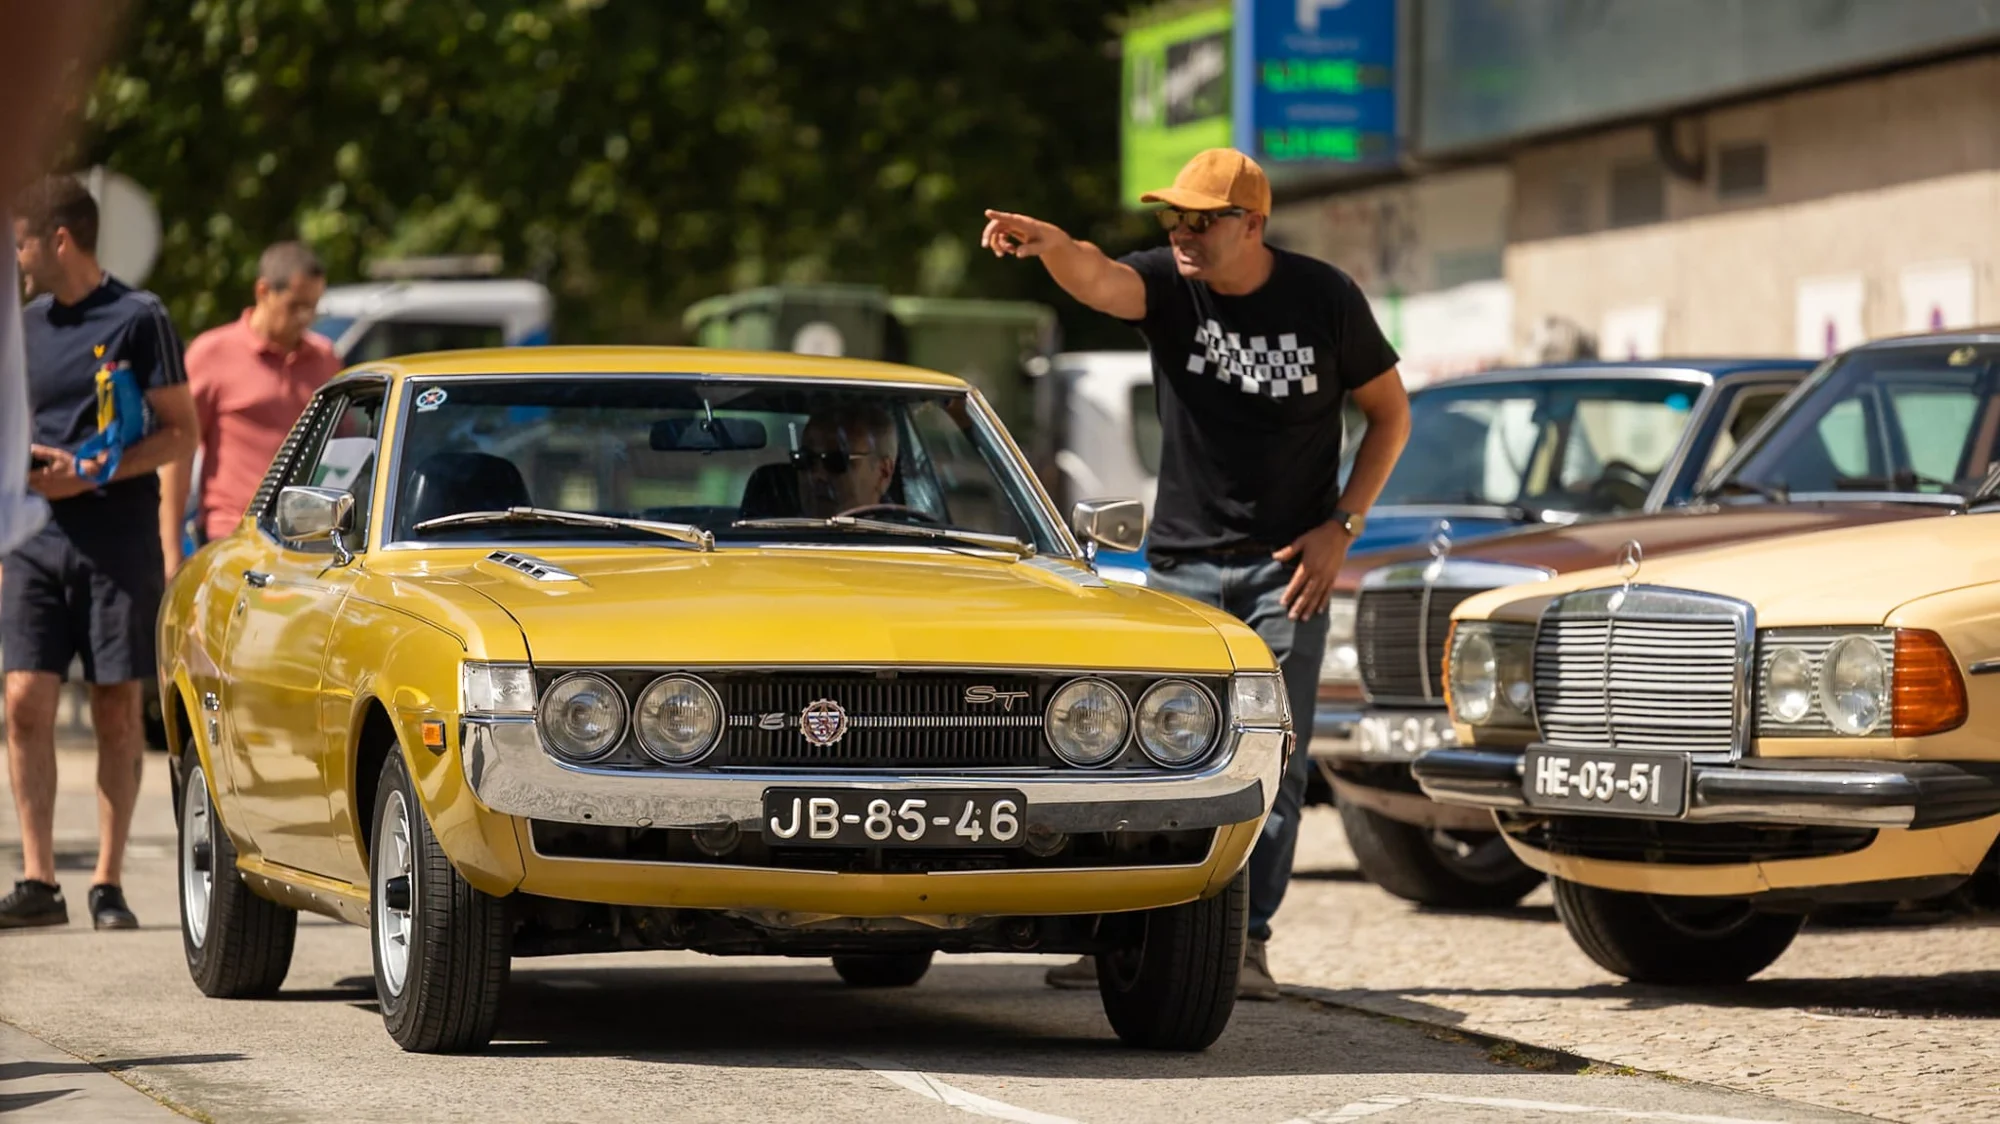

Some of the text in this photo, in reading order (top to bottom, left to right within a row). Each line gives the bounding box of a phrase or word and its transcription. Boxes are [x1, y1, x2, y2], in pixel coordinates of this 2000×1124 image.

[964, 685, 1029, 712] ST
[1536, 756, 1661, 804] HE-03-51
[770, 797, 1018, 841] JB-85-46
